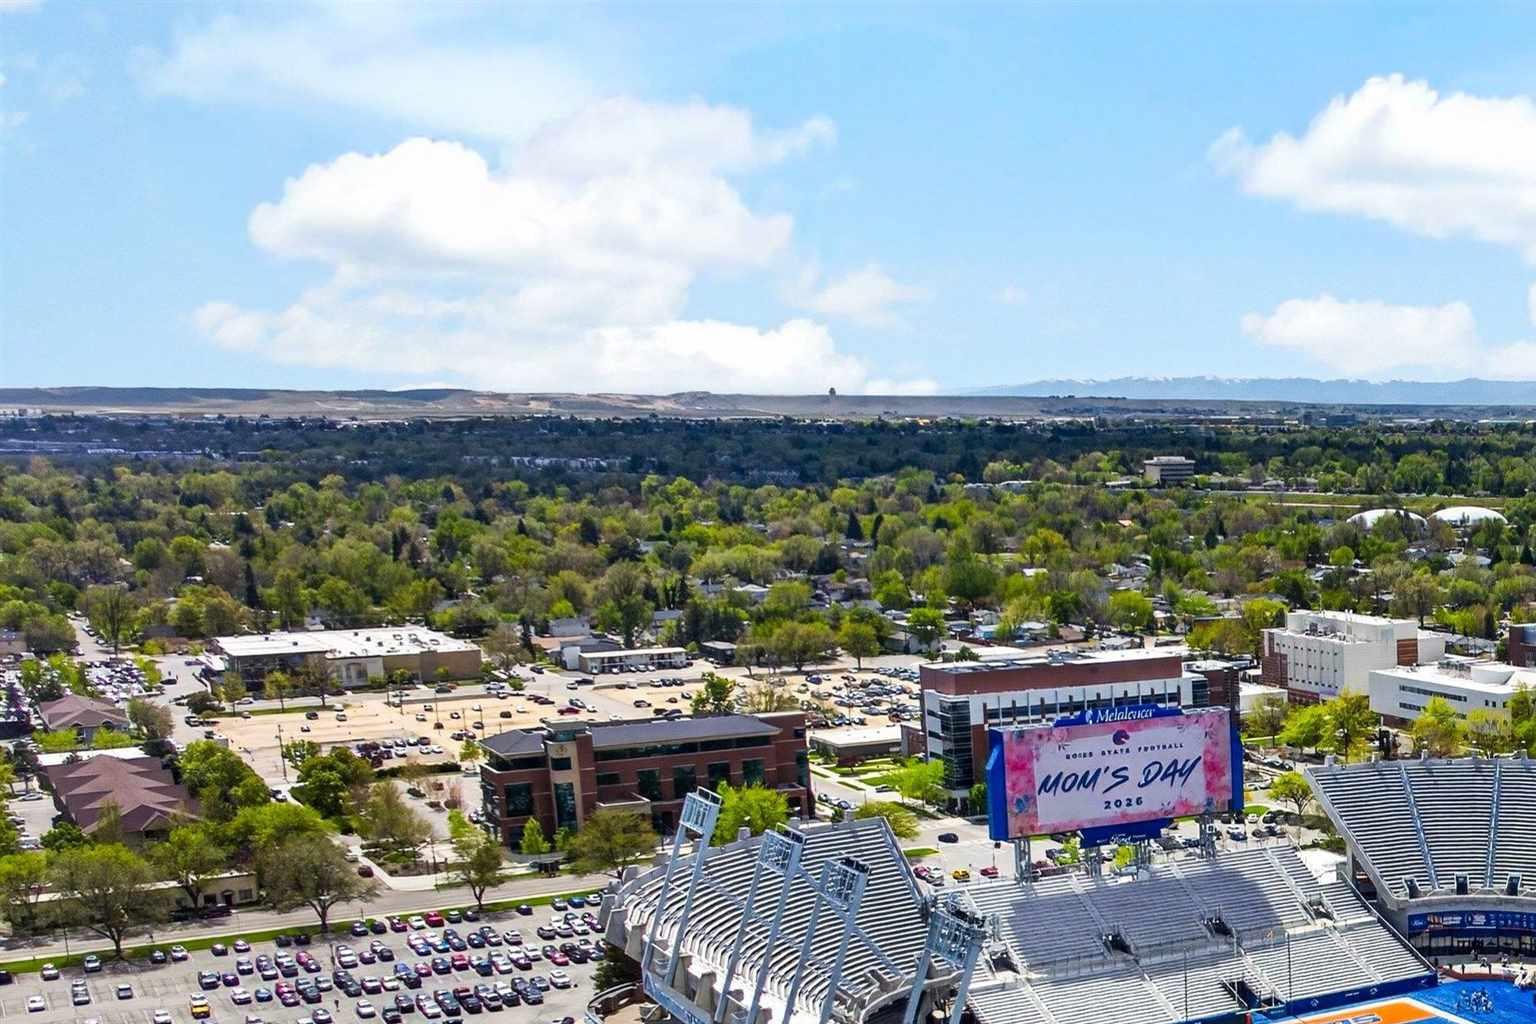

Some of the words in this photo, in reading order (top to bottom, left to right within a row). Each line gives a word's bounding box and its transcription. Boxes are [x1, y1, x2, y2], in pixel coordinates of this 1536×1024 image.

[1101, 748, 1130, 756] STATE
[1137, 742, 1184, 753] FOOTBALL
[1038, 765, 1130, 797] MOM'S
[1138, 755, 1202, 787] DAY
[1104, 797, 1144, 810] 2026
